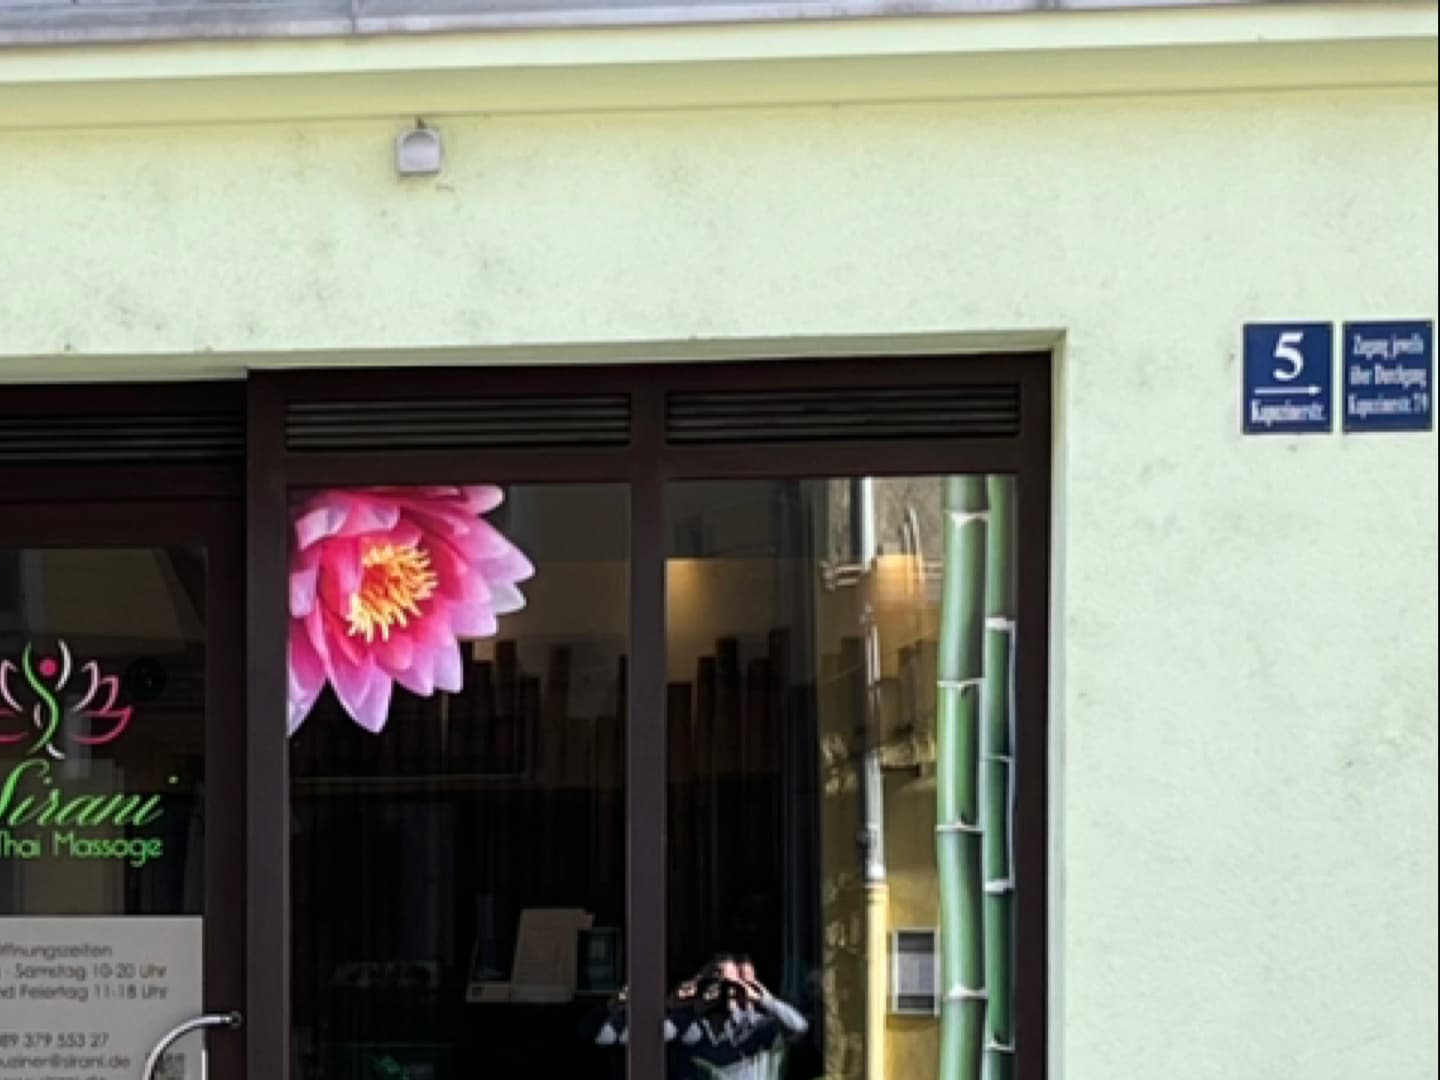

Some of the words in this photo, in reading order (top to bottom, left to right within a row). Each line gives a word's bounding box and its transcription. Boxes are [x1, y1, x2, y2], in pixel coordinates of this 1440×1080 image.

[1272, 331, 1305, 381] 5
[51, 830, 163, 868] Massage
[14, 963, 87, 982] Samstag
[138, 963, 168, 980] Uhr
[18, 983, 89, 1003] Feiertag
[141, 984, 168, 1001] Uhr
[23, 1031, 53, 1049] 379
[57, 1031, 86, 1049] 553
[89, 1031, 110, 1049] 27
